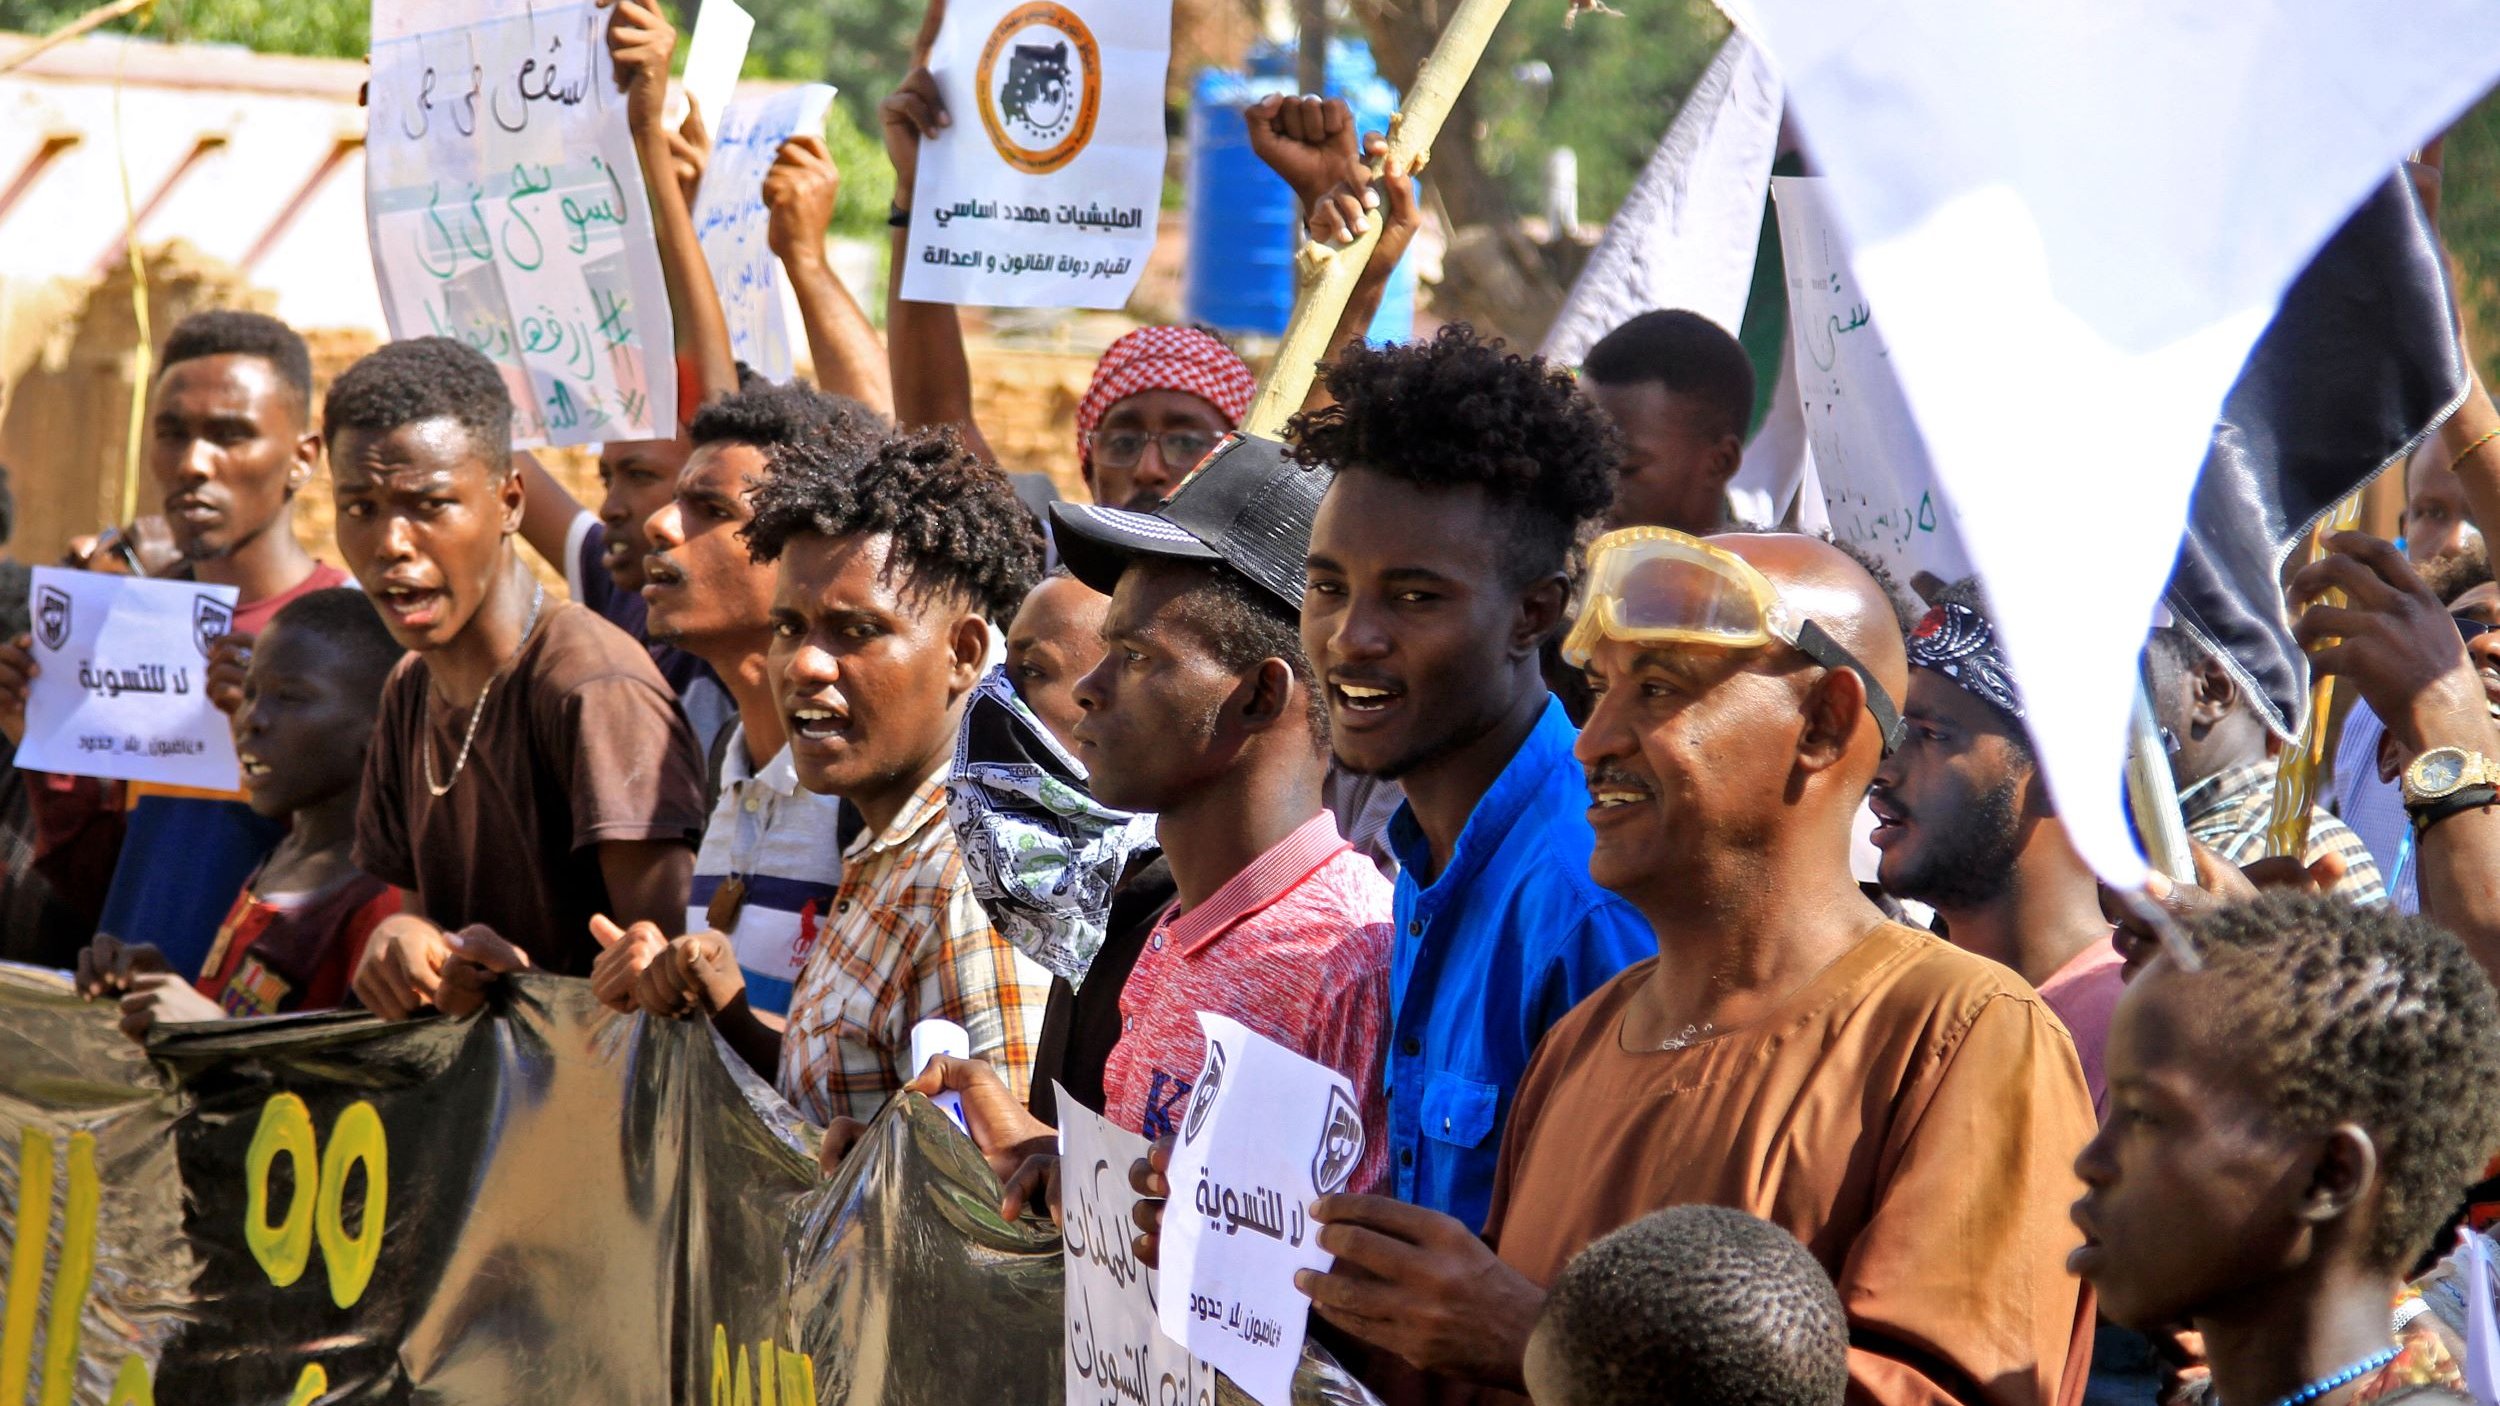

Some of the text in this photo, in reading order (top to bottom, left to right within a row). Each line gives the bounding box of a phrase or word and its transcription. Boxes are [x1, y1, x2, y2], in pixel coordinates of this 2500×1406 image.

[935, 199, 1143, 232] المليشيات مهدد اساسي
[923, 246, 1131, 279] لقيام دولة القانون و العدالة
[78, 659, 189, 698] لا للتسوية
[1195, 1166, 1306, 1248] لا للتسوية
